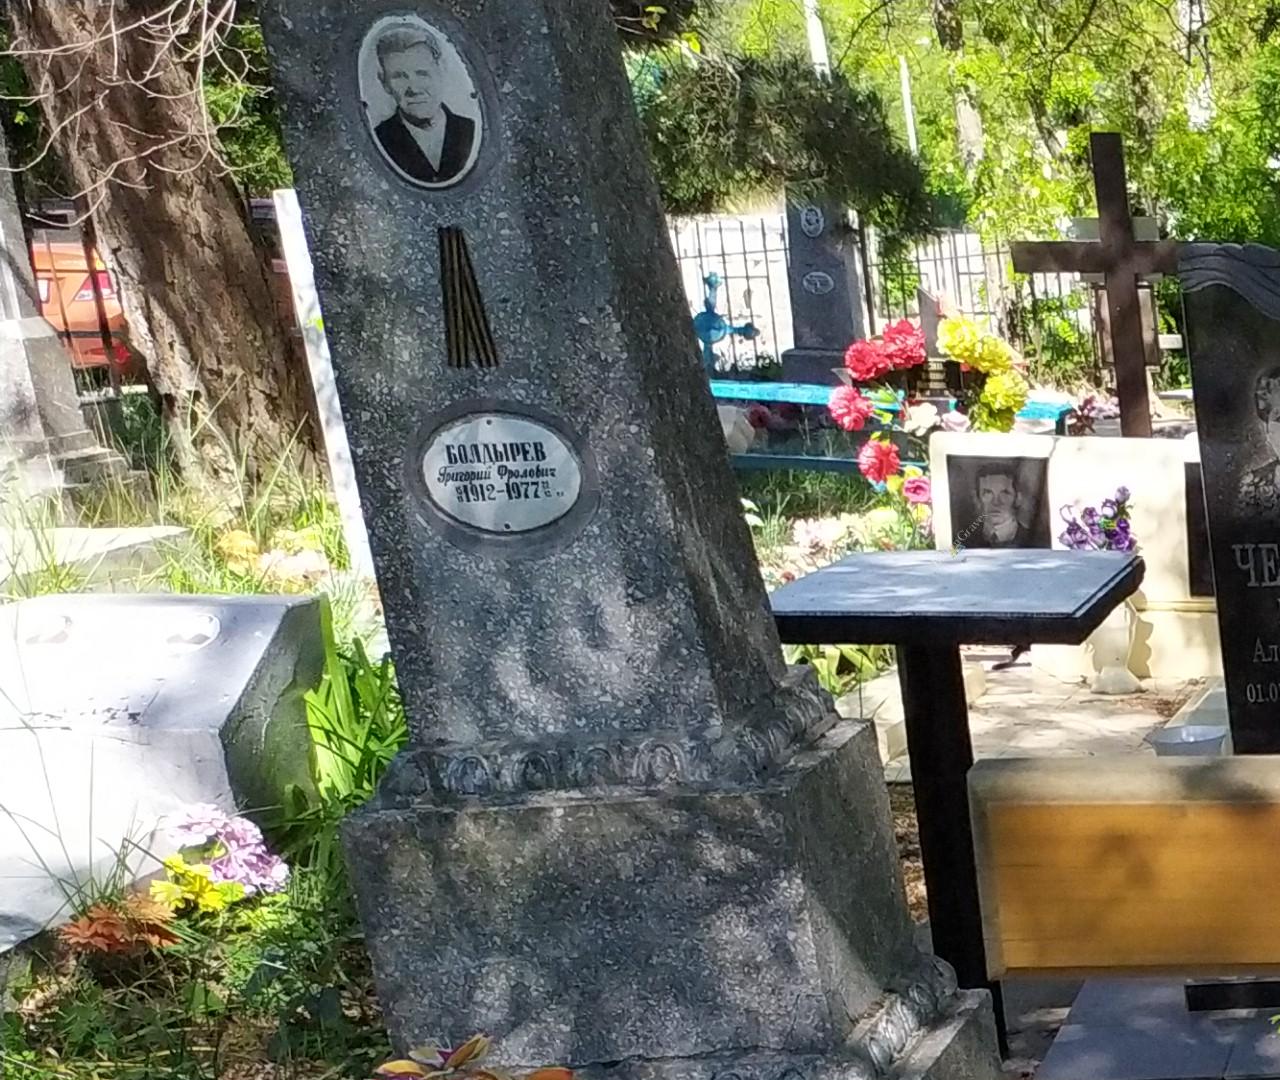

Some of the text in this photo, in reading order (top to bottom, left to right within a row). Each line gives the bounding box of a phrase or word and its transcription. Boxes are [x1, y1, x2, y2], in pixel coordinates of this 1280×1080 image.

[445, 441, 547, 465] БОЛДЫРЕВ
[437, 464, 556, 486] Григорий Фролович
